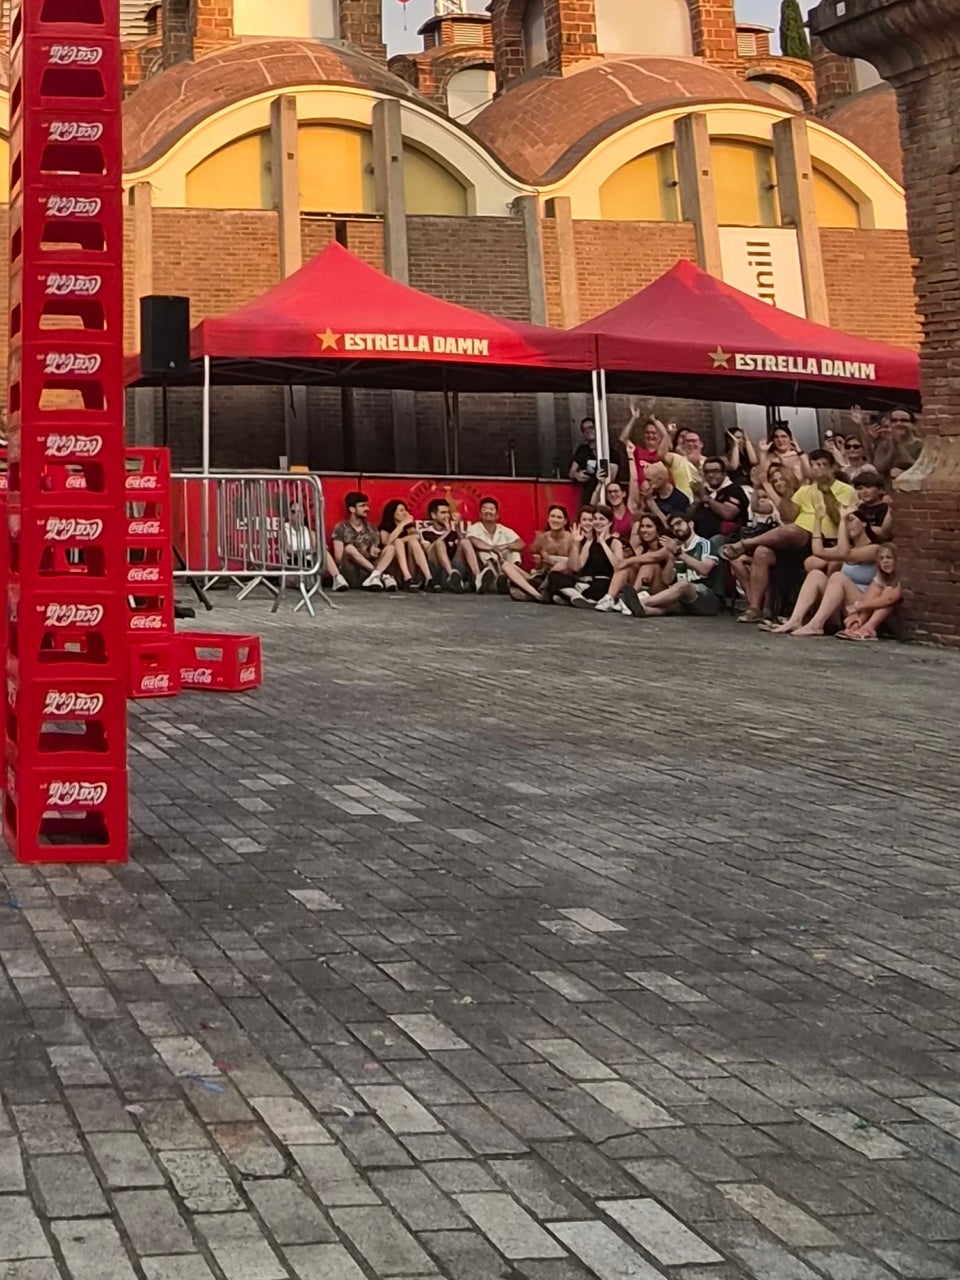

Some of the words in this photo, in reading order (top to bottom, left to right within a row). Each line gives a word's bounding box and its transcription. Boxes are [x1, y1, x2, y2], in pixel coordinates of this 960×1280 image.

[344, 333, 430, 353] ESTRELLA
[433, 336, 489, 356] DAMM
[735, 353, 818, 375] ESTRELLA
[821, 359, 876, 380] DAMM
